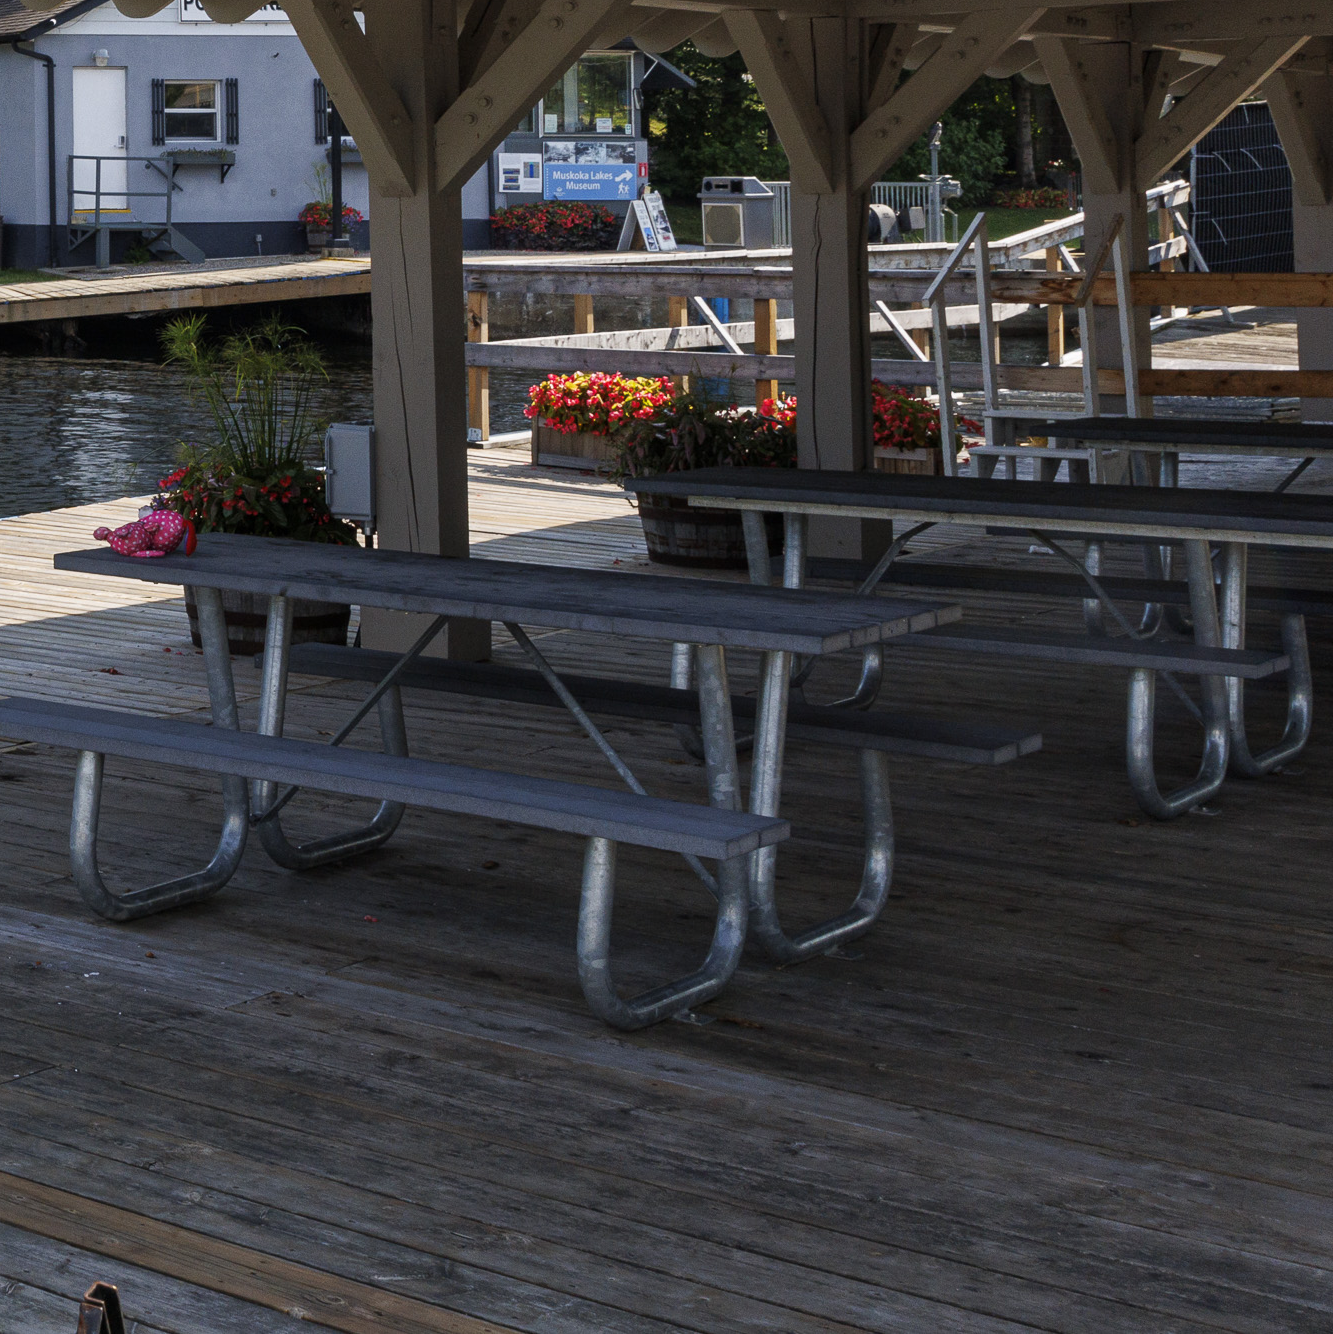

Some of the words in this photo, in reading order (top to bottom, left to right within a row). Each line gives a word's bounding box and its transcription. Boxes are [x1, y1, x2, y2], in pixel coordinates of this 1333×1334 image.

[553, 170, 589, 180] Muskoka
[590, 170, 613, 180] Lakes
[566, 181, 600, 190] Museum
